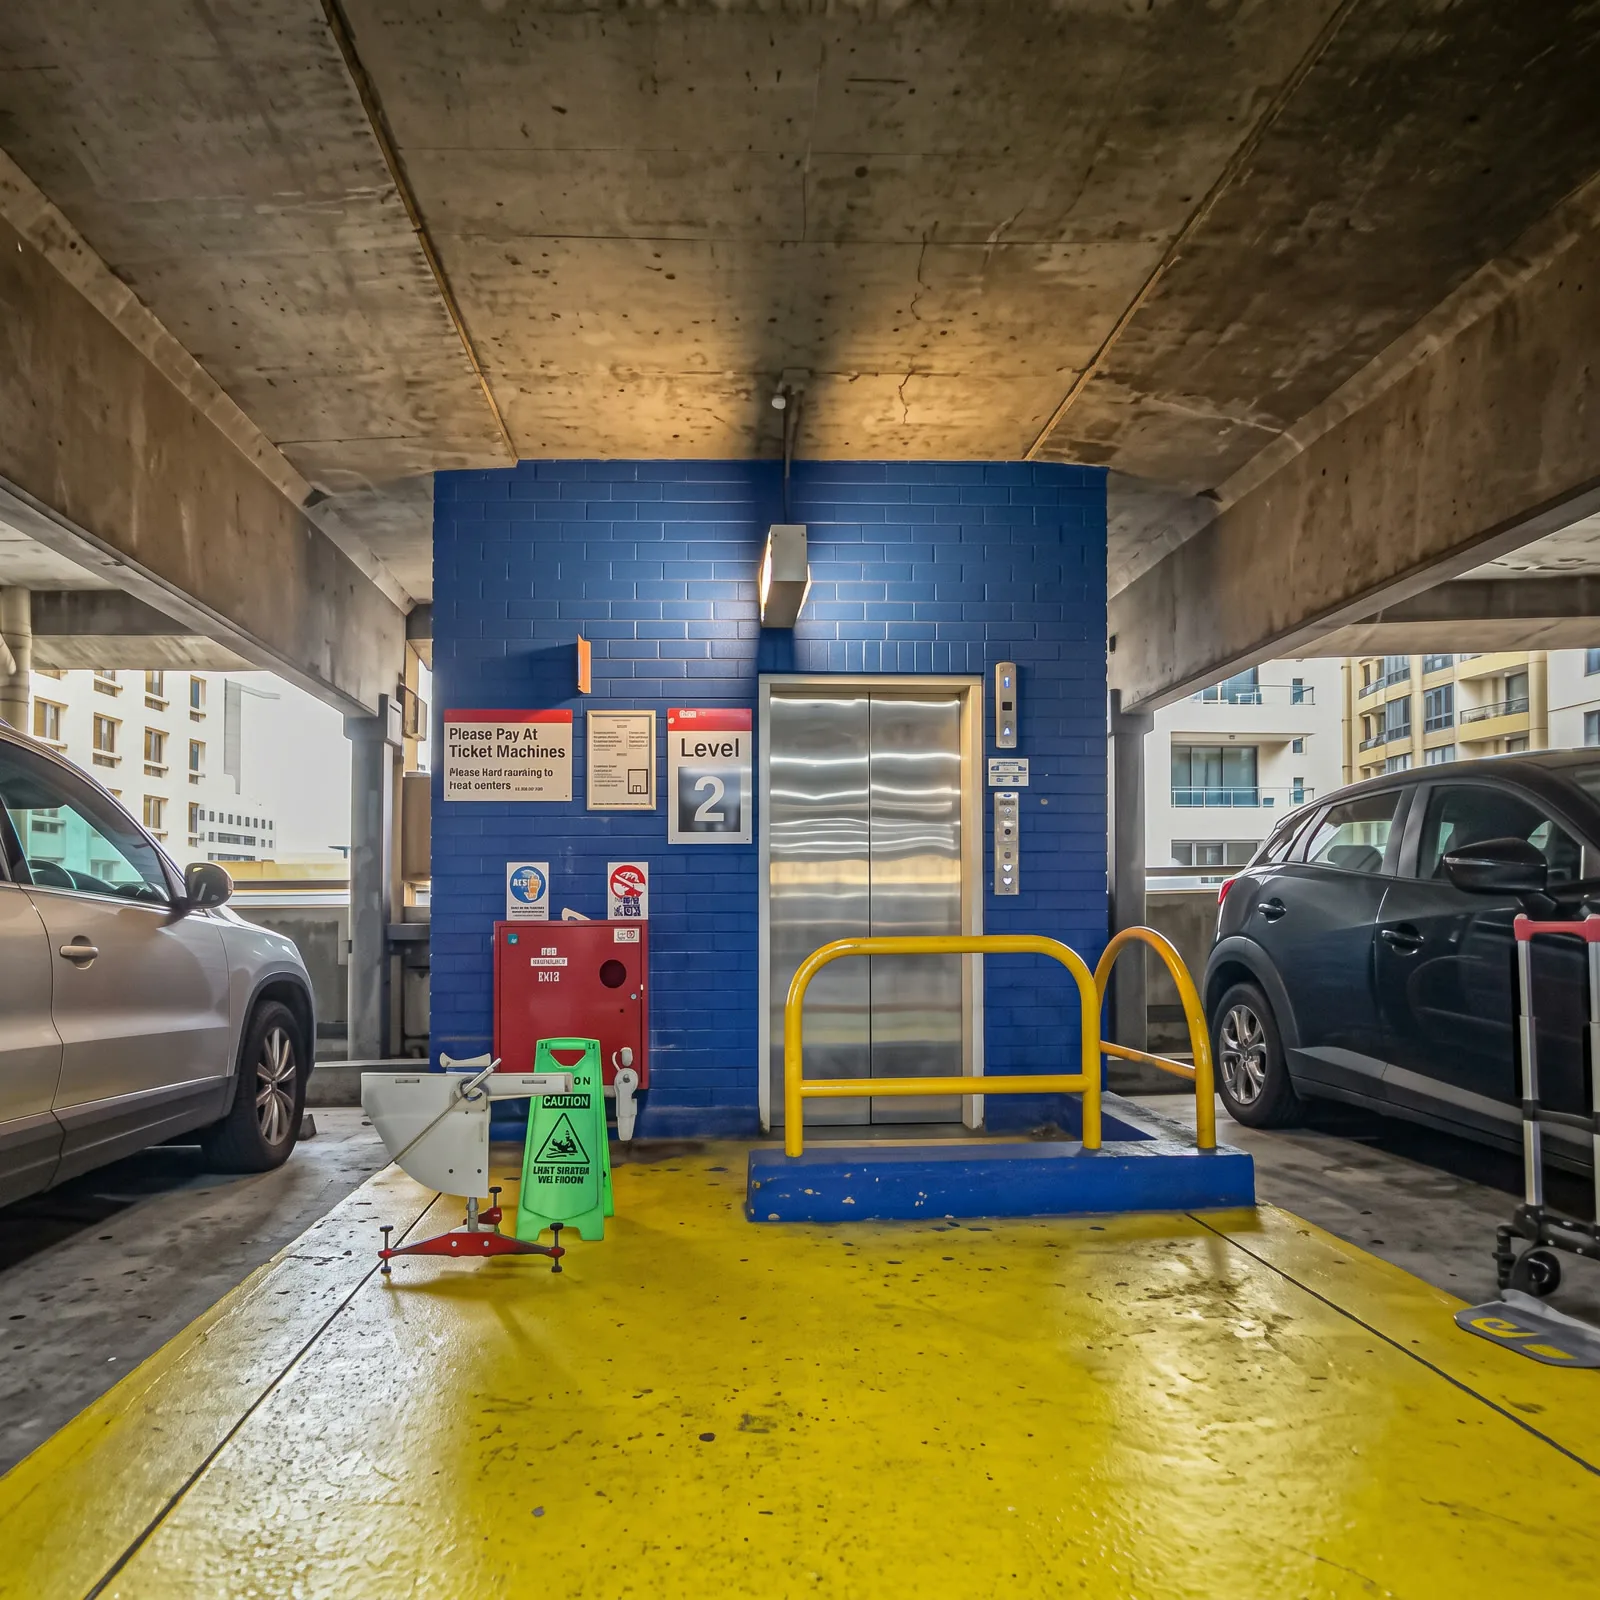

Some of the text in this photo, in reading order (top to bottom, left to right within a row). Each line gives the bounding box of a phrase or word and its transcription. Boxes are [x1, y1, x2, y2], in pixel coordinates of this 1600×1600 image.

[449, 727, 538, 743] Please Pay At
[449, 744, 566, 758] Ticket Machines
[681, 738, 739, 757] Level
[544, 767, 553, 777] to
[693, 775, 725, 822] 2
[543, 1095, 589, 1107] CAUTION
